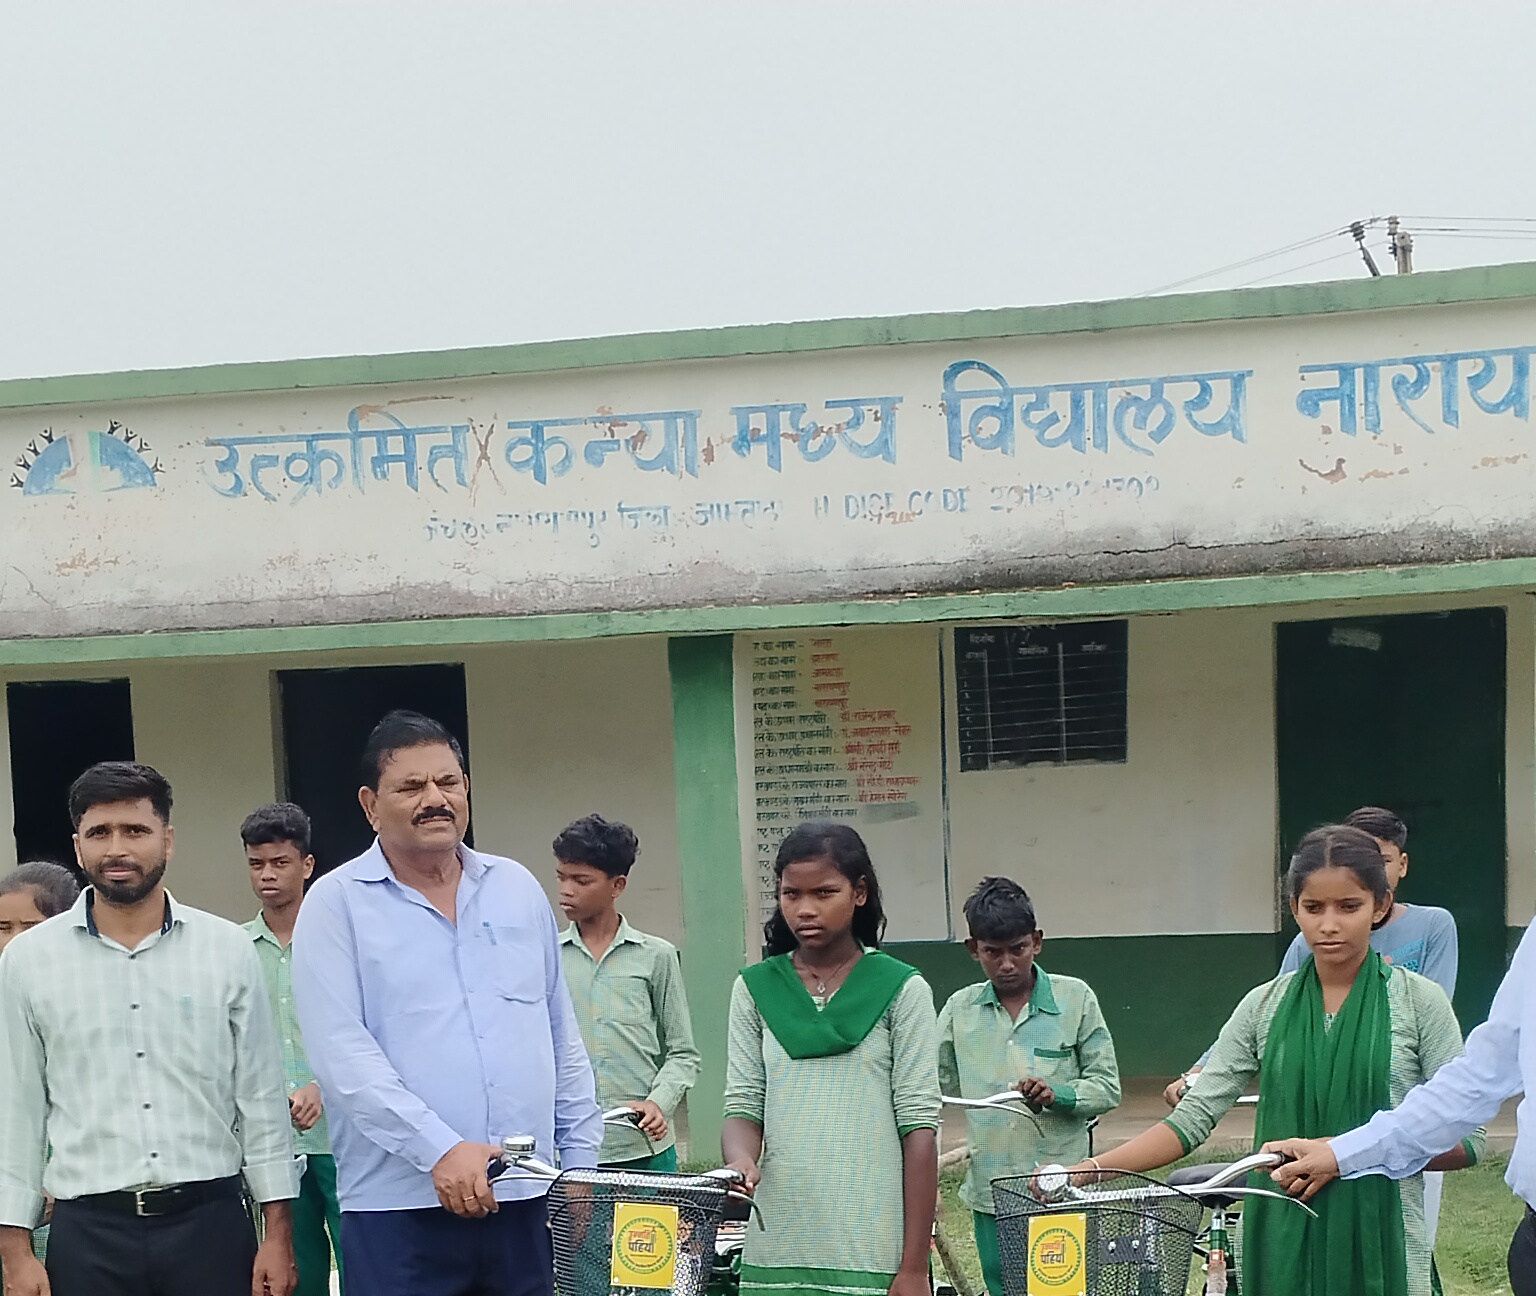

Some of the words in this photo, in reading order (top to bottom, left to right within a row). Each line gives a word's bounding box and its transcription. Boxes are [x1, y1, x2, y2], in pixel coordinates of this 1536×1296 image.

[505, 409, 702, 485] कन्या
[731, 396, 903, 472] मध्य
[941, 360, 1253, 462] विद्यालय
